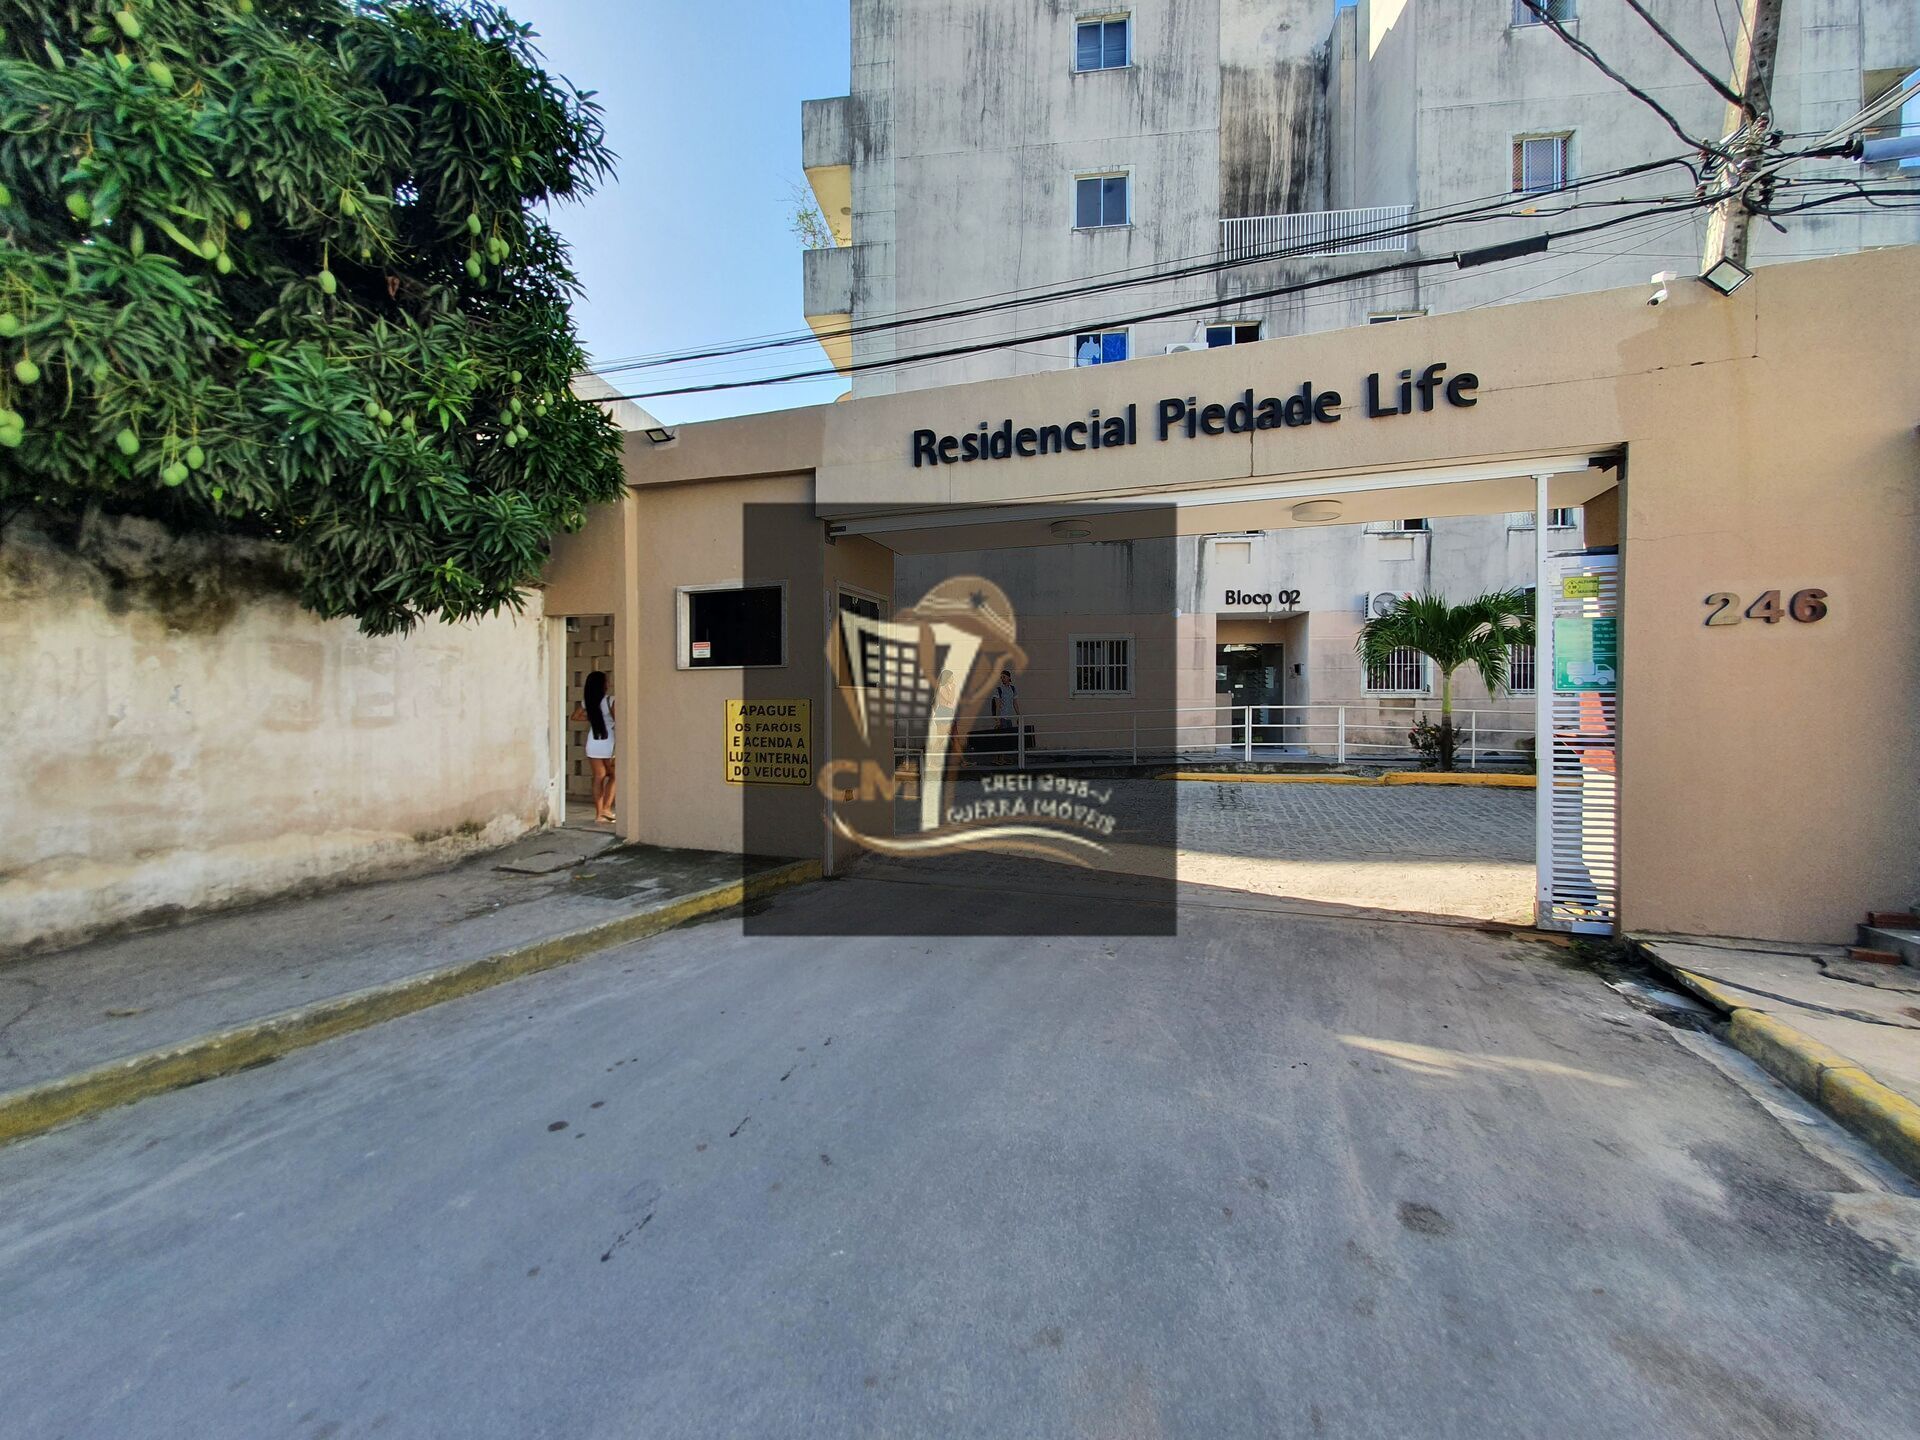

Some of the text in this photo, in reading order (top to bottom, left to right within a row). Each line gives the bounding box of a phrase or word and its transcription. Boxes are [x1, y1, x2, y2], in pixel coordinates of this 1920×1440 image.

[913, 362, 1480, 468] Residencial Piedade Life
[1225, 589, 1301, 605] Bloco 02
[1704, 588, 1828, 626] 246
[739, 705, 796, 716] APAGUE
[735, 721, 801, 732] OS FARÓIS
[733, 736, 805, 748] E ACENDA A
[729, 751, 808, 764] LUZ INTERNA
[734, 764, 807, 778] DO VEÍCULO
